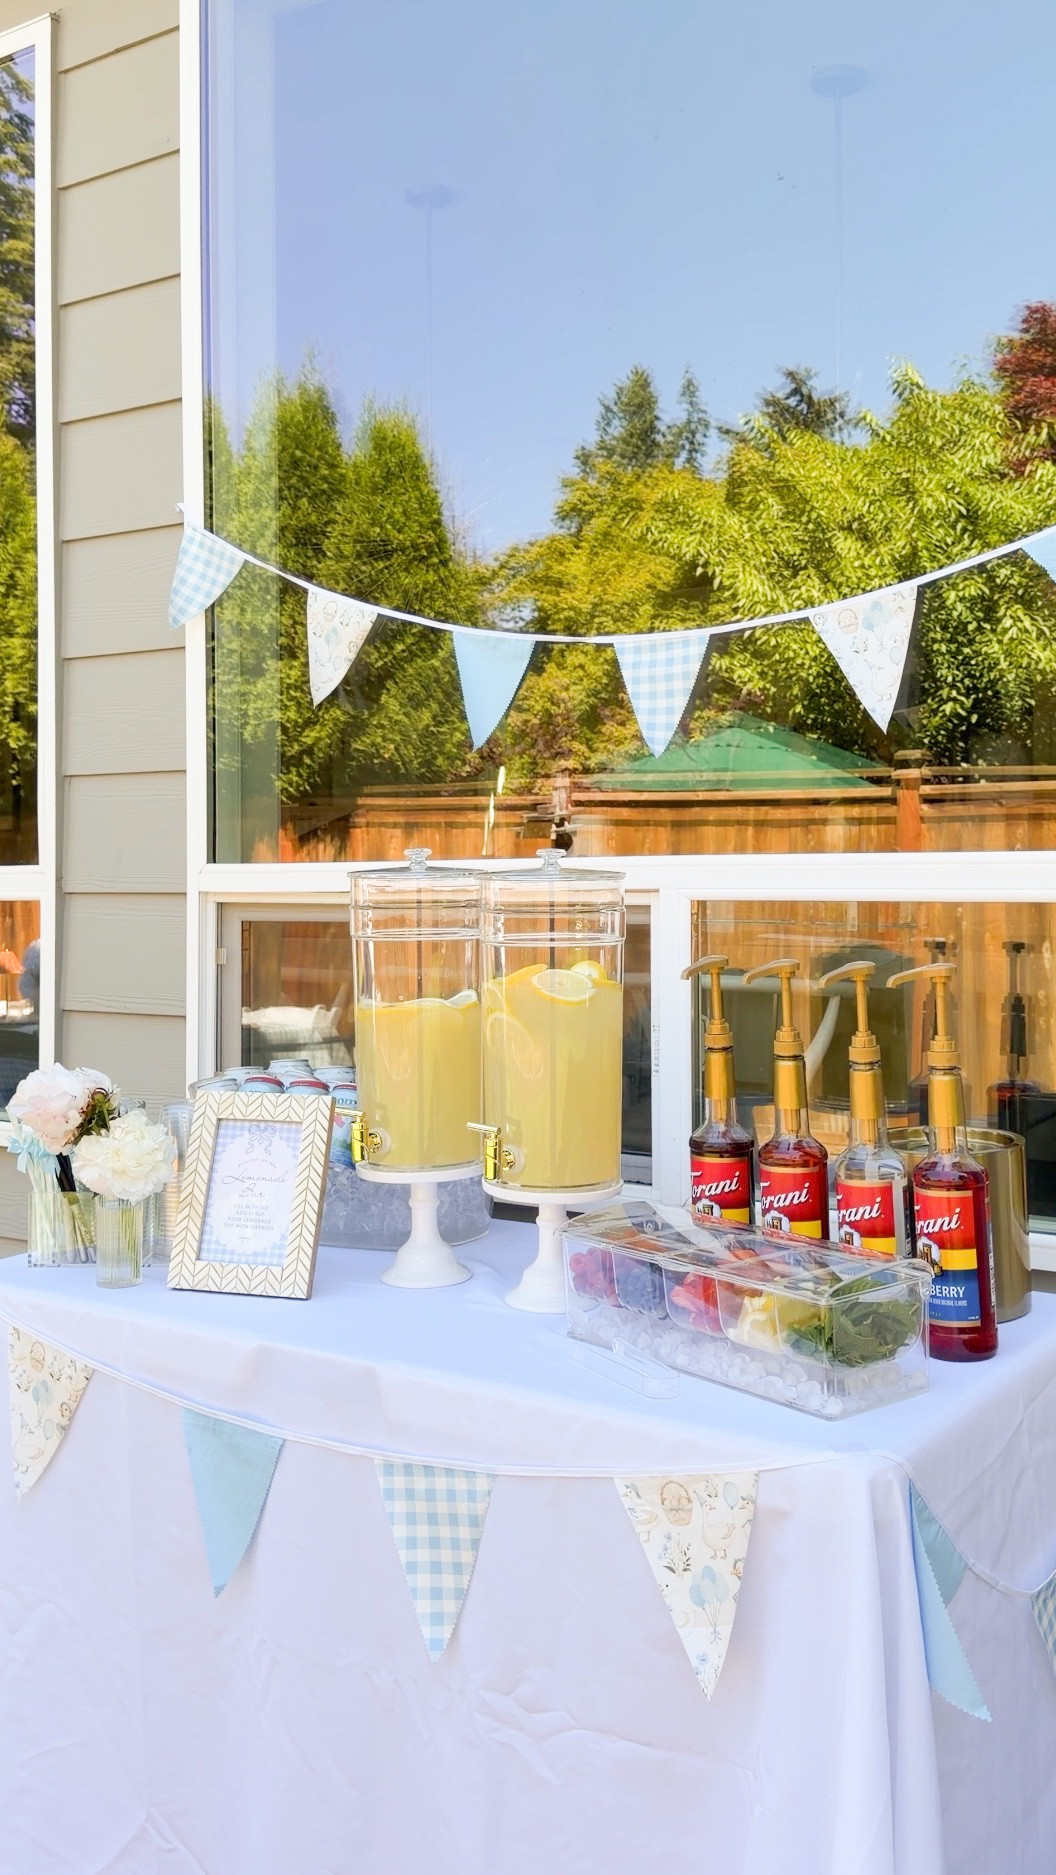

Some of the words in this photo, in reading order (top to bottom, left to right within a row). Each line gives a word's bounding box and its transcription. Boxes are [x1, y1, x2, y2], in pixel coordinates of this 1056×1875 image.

[222, 1168, 288, 1185] Lemonade
[239, 1183, 266, 1198] Bar
[836, 1194, 882, 1222] rani
[914, 1205, 961, 1234] rani
